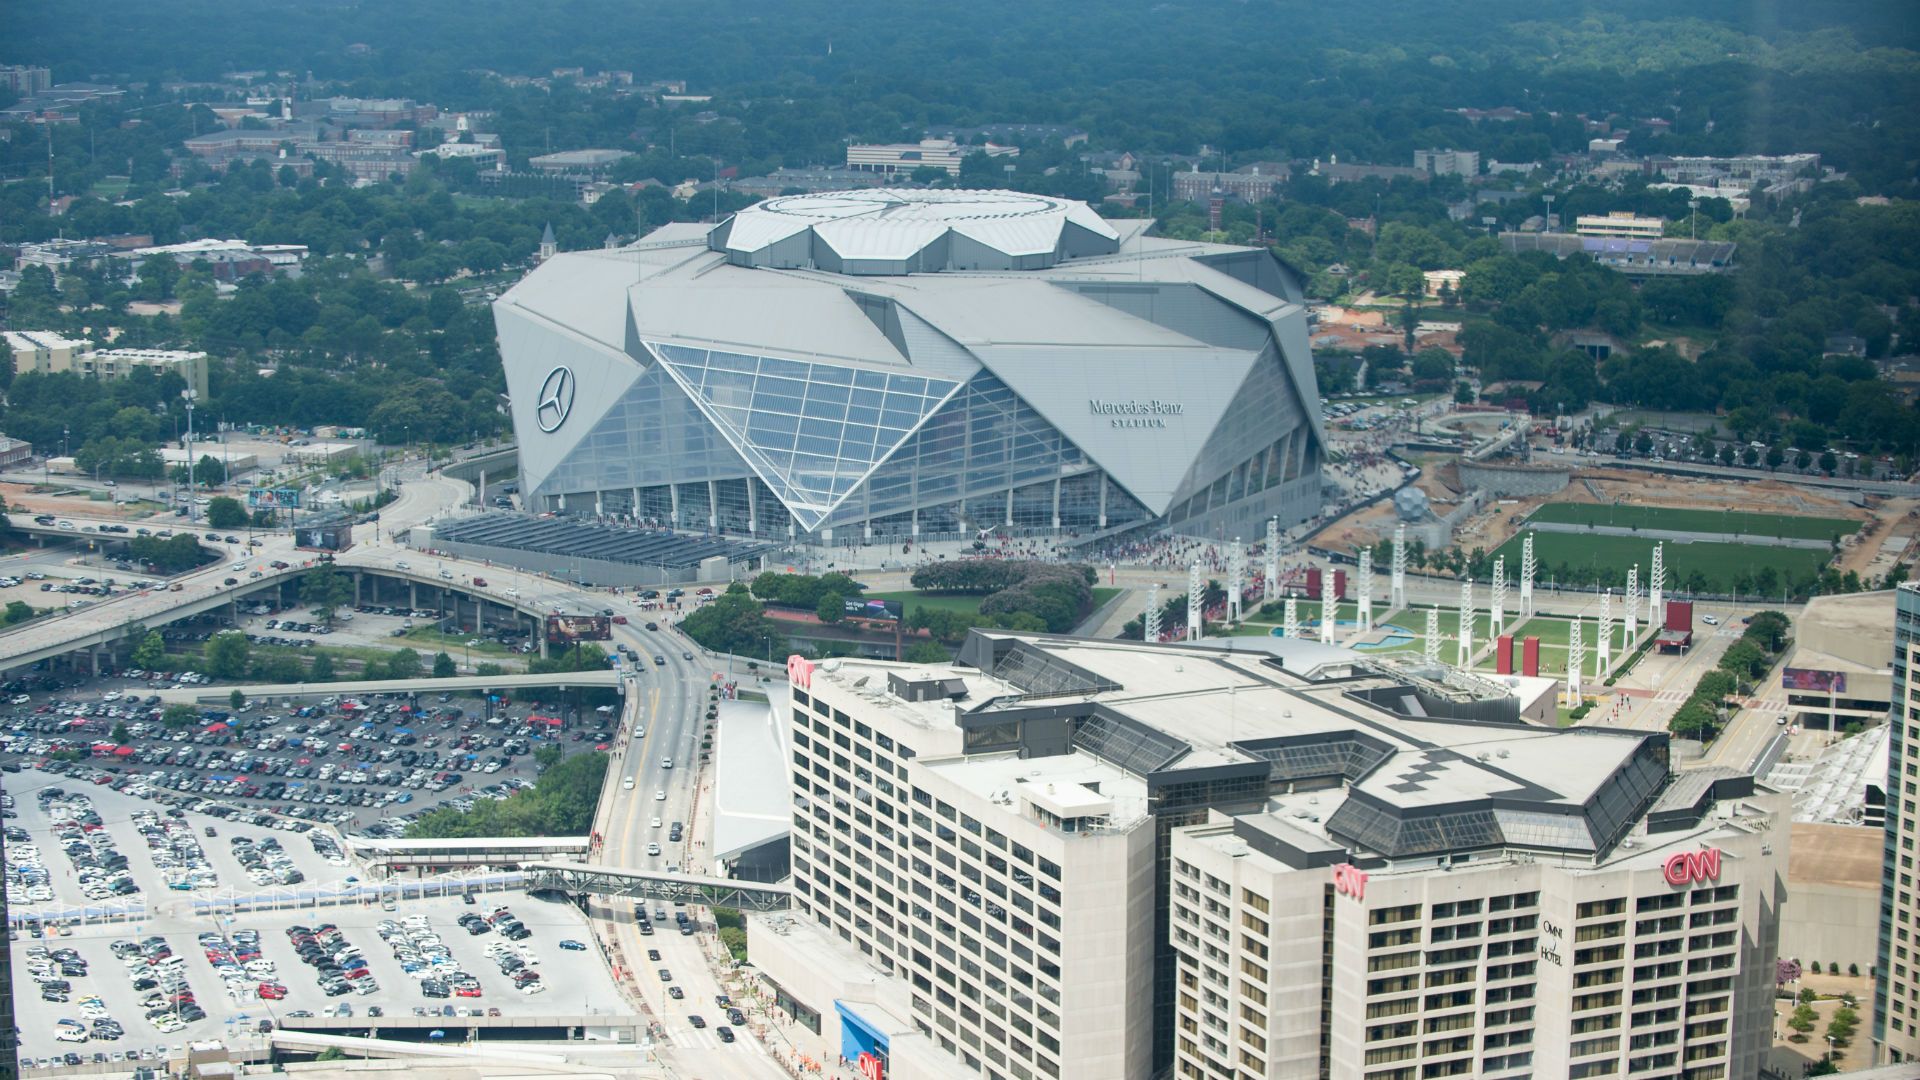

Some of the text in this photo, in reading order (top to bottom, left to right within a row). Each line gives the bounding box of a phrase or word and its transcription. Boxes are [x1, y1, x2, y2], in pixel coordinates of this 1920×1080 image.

[1090, 399, 1184, 415] Mercedes-Benz
[1112, 419, 1167, 428] STADIUM
[788, 654, 815, 689] CNN
[1664, 848, 1721, 885] CNN
[1334, 863, 1369, 902] CNN
[1543, 920, 1563, 939] OMNI
[1541, 946, 1563, 968] HOTEL
[858, 1052, 883, 1080] CNN
